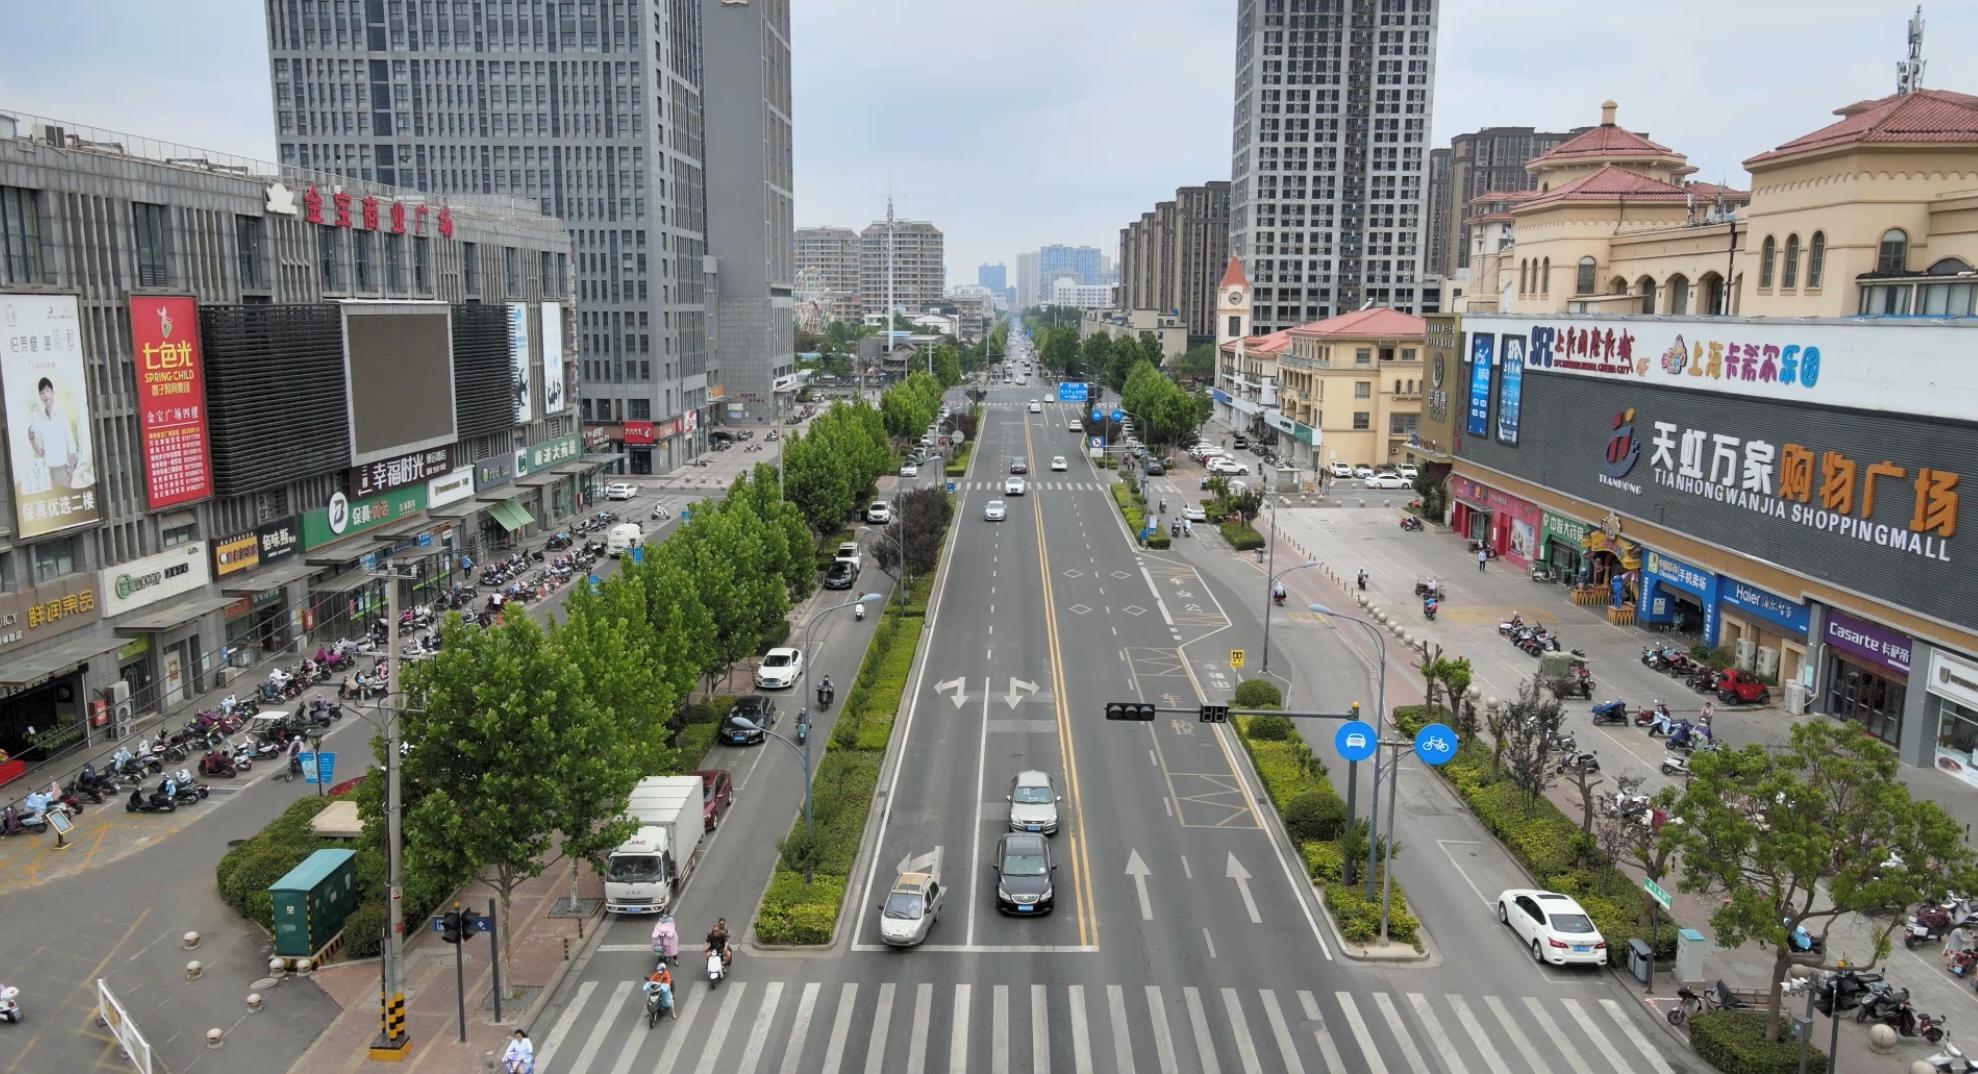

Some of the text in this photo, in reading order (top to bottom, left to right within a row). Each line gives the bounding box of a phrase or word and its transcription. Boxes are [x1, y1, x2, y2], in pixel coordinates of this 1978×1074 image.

[303, 183, 453, 240] 金宝商业广场
[142, 340, 194, 369] 七色光
[1530, 325, 1554, 368] SFC
[144, 370, 195, 383] SPRING CHILD
[1688, 340, 1820, 388] 上海卡希尔乐园
[372, 453, 425, 490] 幸福时光
[1599, 473, 1643, 495] TIANHONG
[1651, 421, 1961, 538] 天虹万家购物广场
[22, 492, 95, 523] 保真优选二楼
[1655, 468, 1951, 562] TIANHONGWANJIA SHOPPINGMALL
[262, 528, 289, 551] 佰味斯
[1550, 516, 1584, 544] 中联大药房
[1679, 568, 1707, 591] 手机卖场
[1736, 584, 1761, 607] Haier
[1829, 621, 1880, 652] Casarte
[1882, 641, 1910, 664] 卡萨帝
